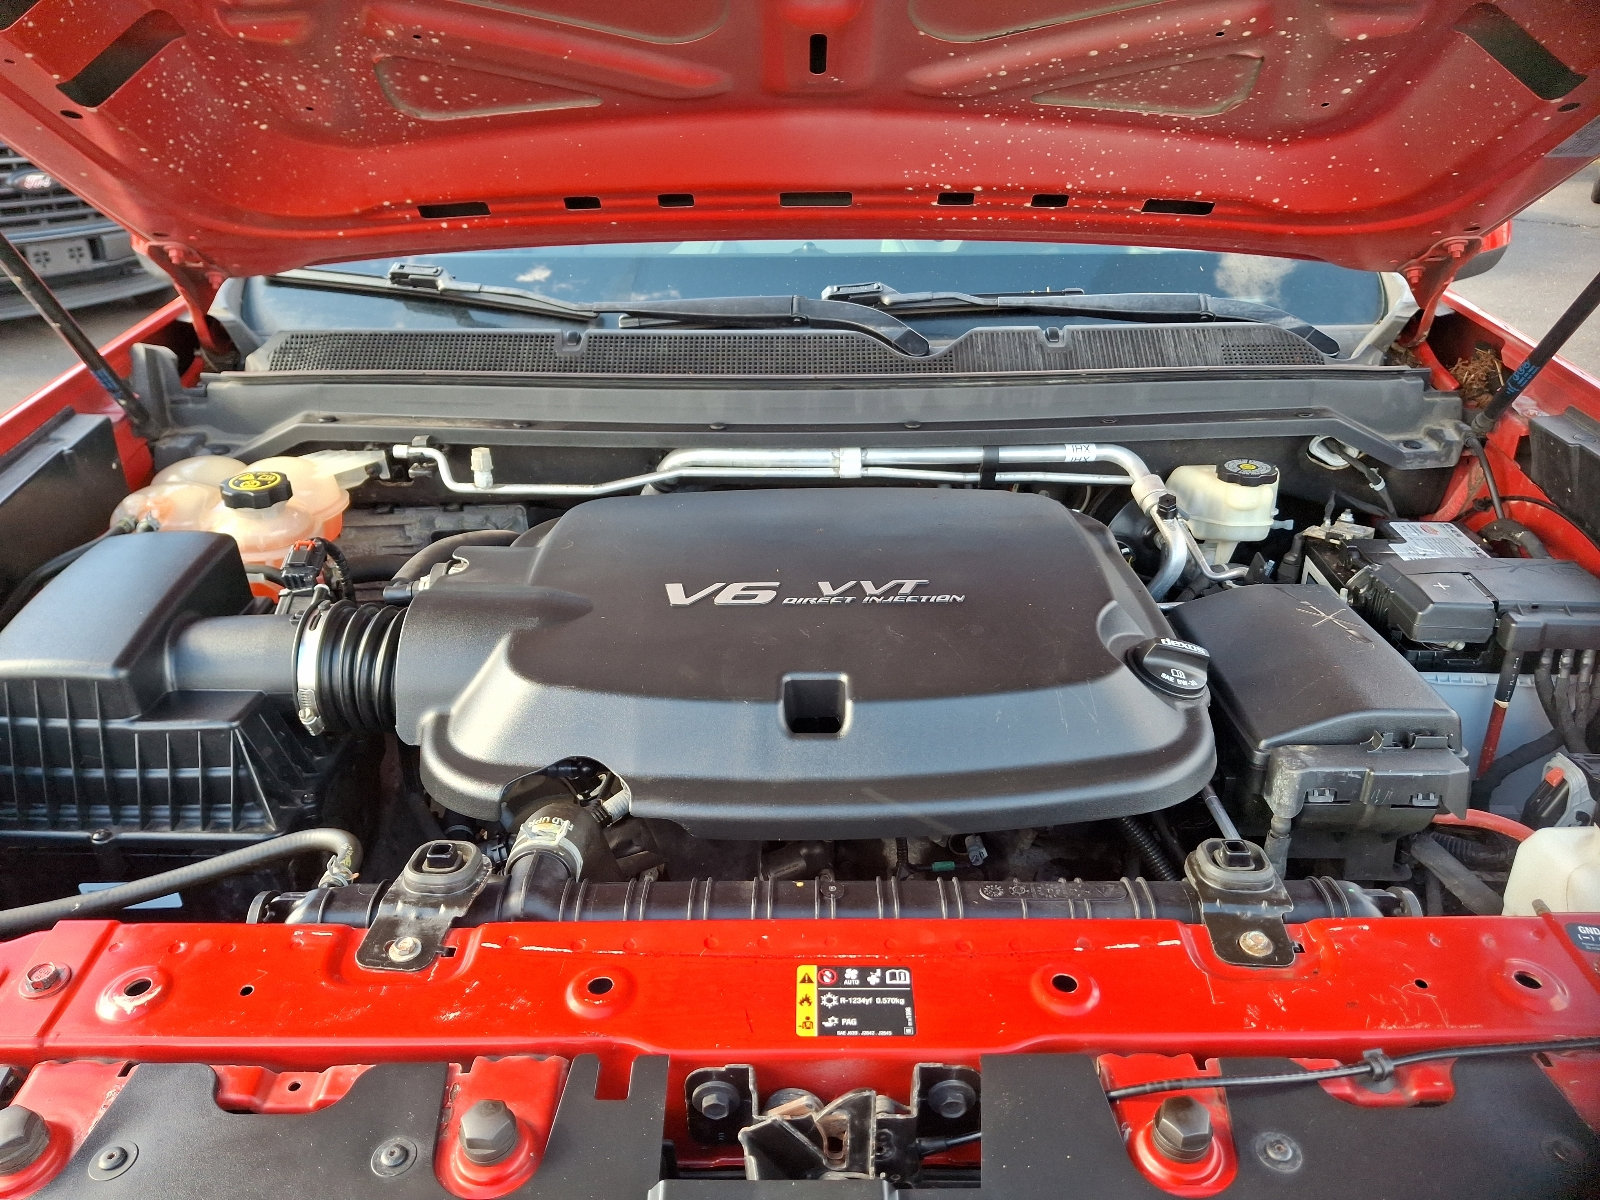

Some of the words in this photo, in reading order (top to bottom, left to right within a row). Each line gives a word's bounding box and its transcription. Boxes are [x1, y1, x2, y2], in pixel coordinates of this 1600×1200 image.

[664, 581, 781, 606] V6
[817, 579, 930, 597] VVT
[782, 596, 857, 605] DIRECT
[862, 594, 966, 604] INJECTION
[839, 997, 873, 1005] R-1234yf
[841, 1018, 857, 1026] PAG
